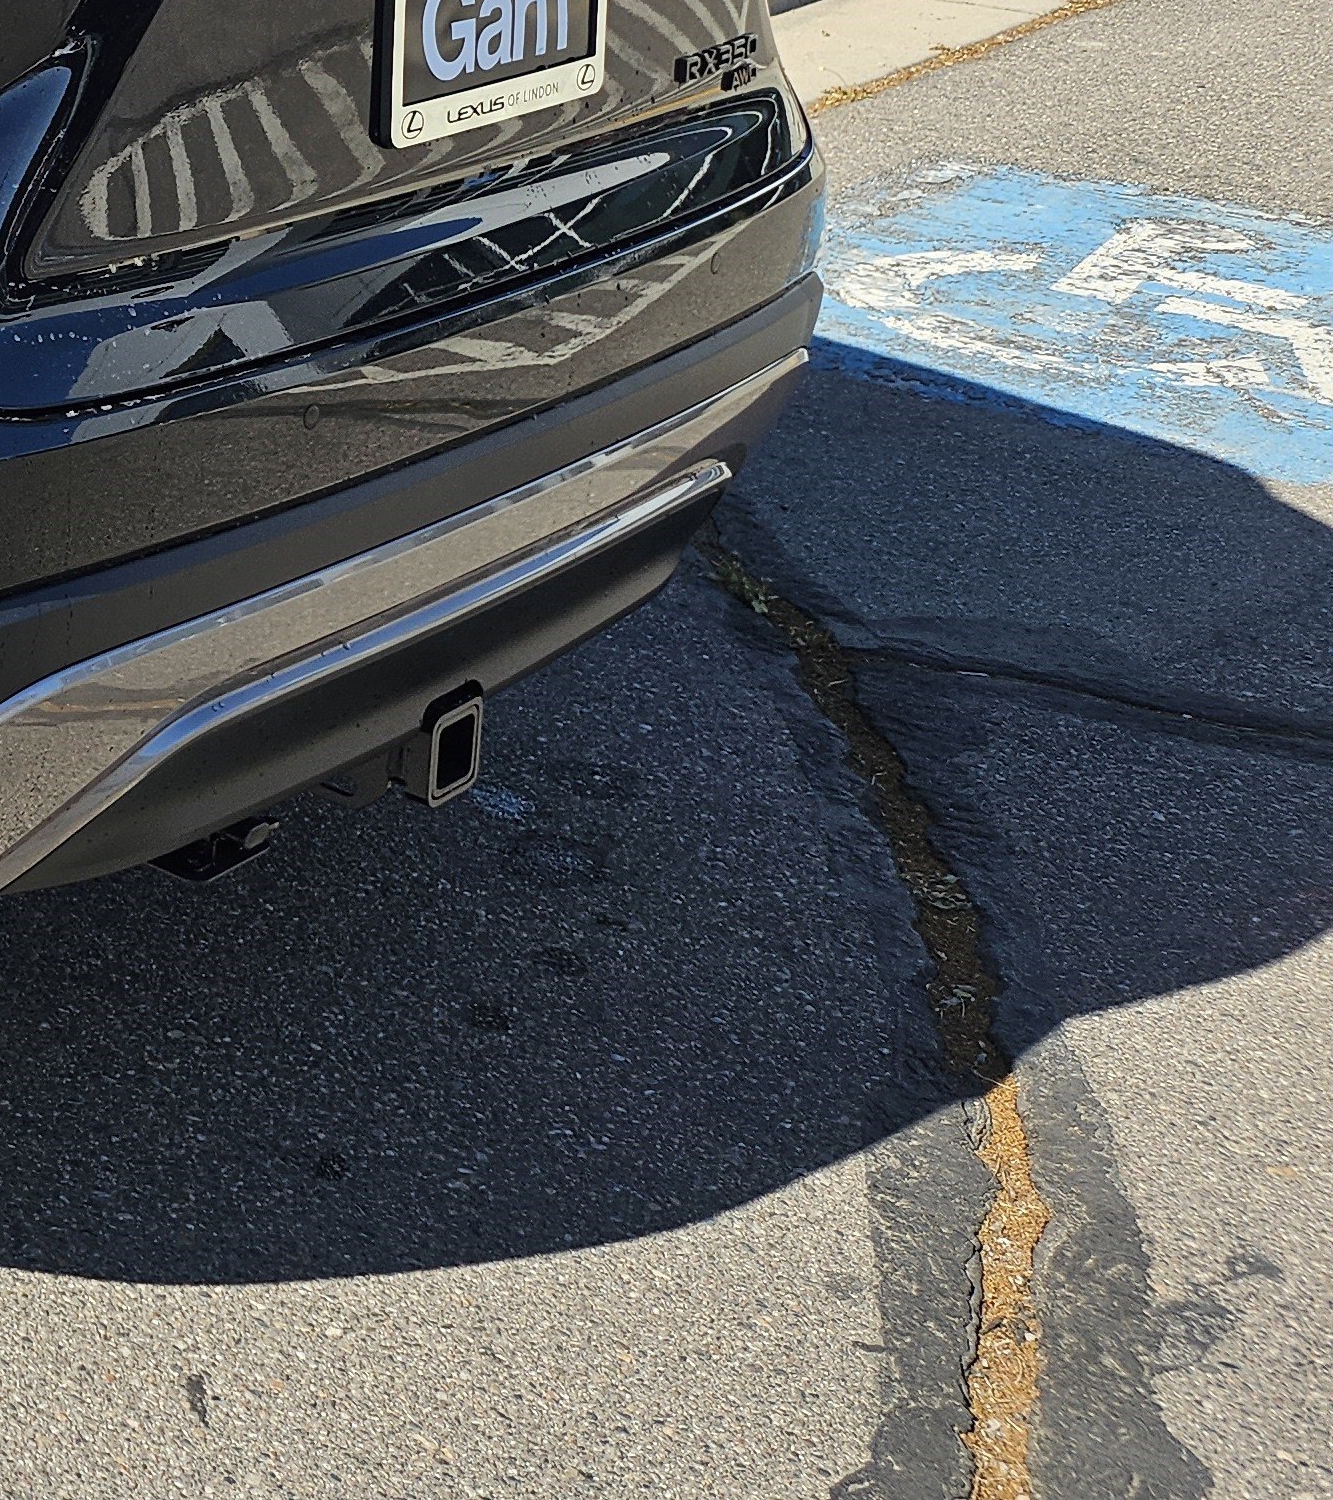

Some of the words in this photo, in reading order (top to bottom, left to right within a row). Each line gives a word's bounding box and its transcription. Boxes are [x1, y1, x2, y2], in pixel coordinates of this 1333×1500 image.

[446, 96, 504, 124] LEXUS
[507, 93, 520, 107] OF
[523, 82, 559, 103] LINDON
